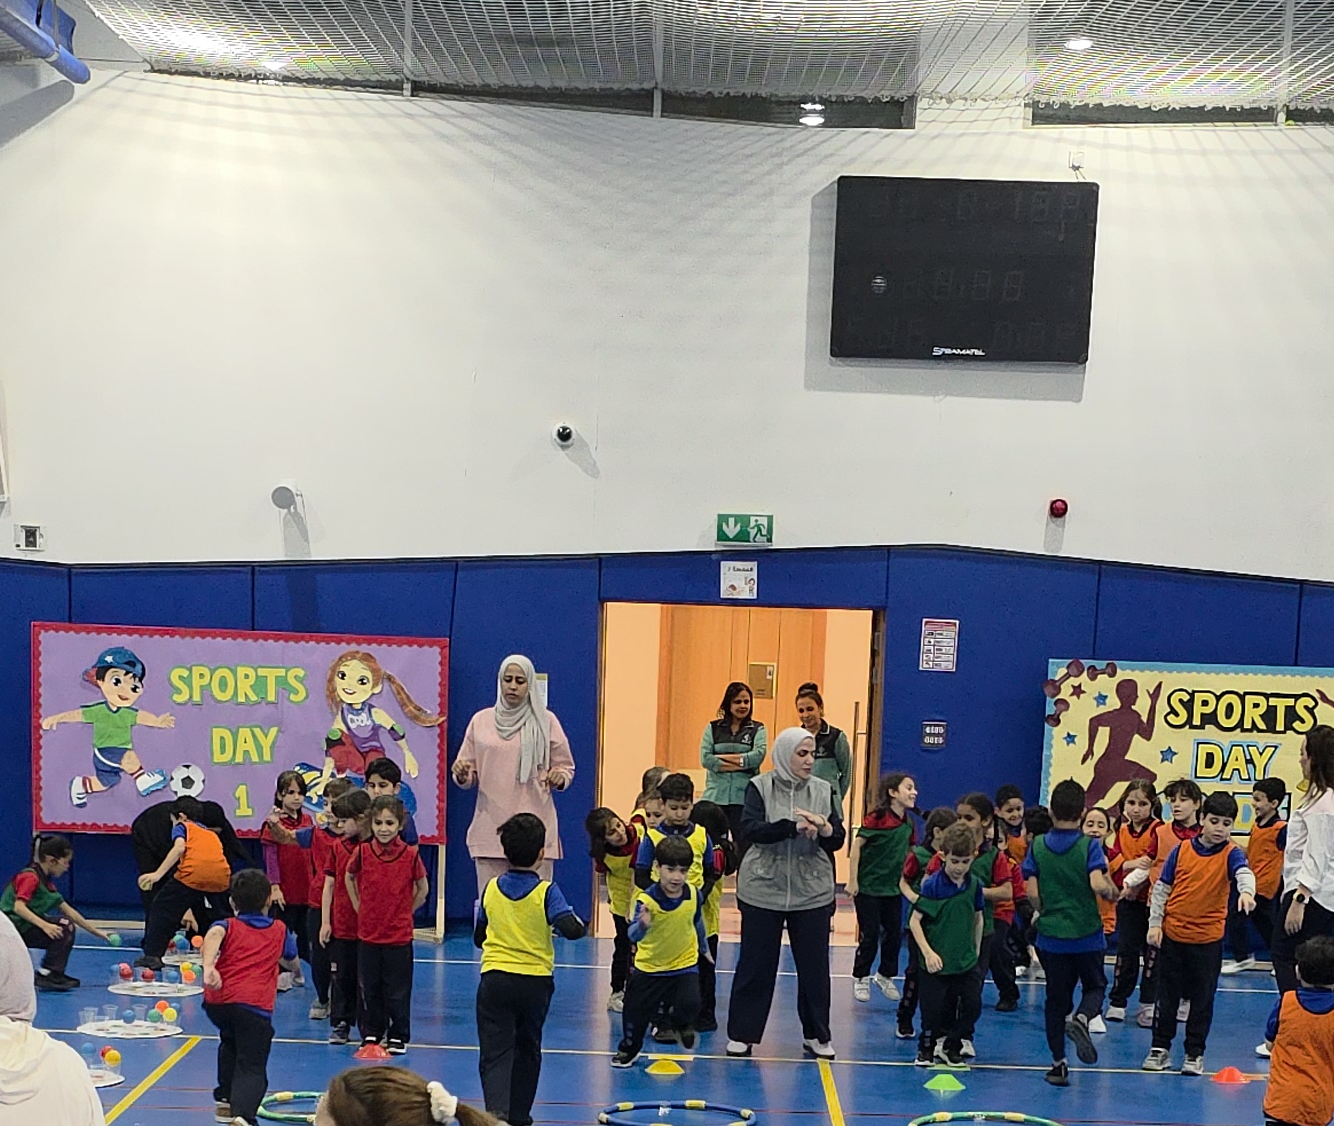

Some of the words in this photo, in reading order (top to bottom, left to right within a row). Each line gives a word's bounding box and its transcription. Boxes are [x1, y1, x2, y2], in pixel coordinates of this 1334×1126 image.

[169, 665, 308, 704] SPORTS
[1164, 688, 1319, 734] SPORTS
[211, 726, 279, 766] DAY
[1194, 742, 1278, 782] DAY
[234, 783, 255, 818] 1
